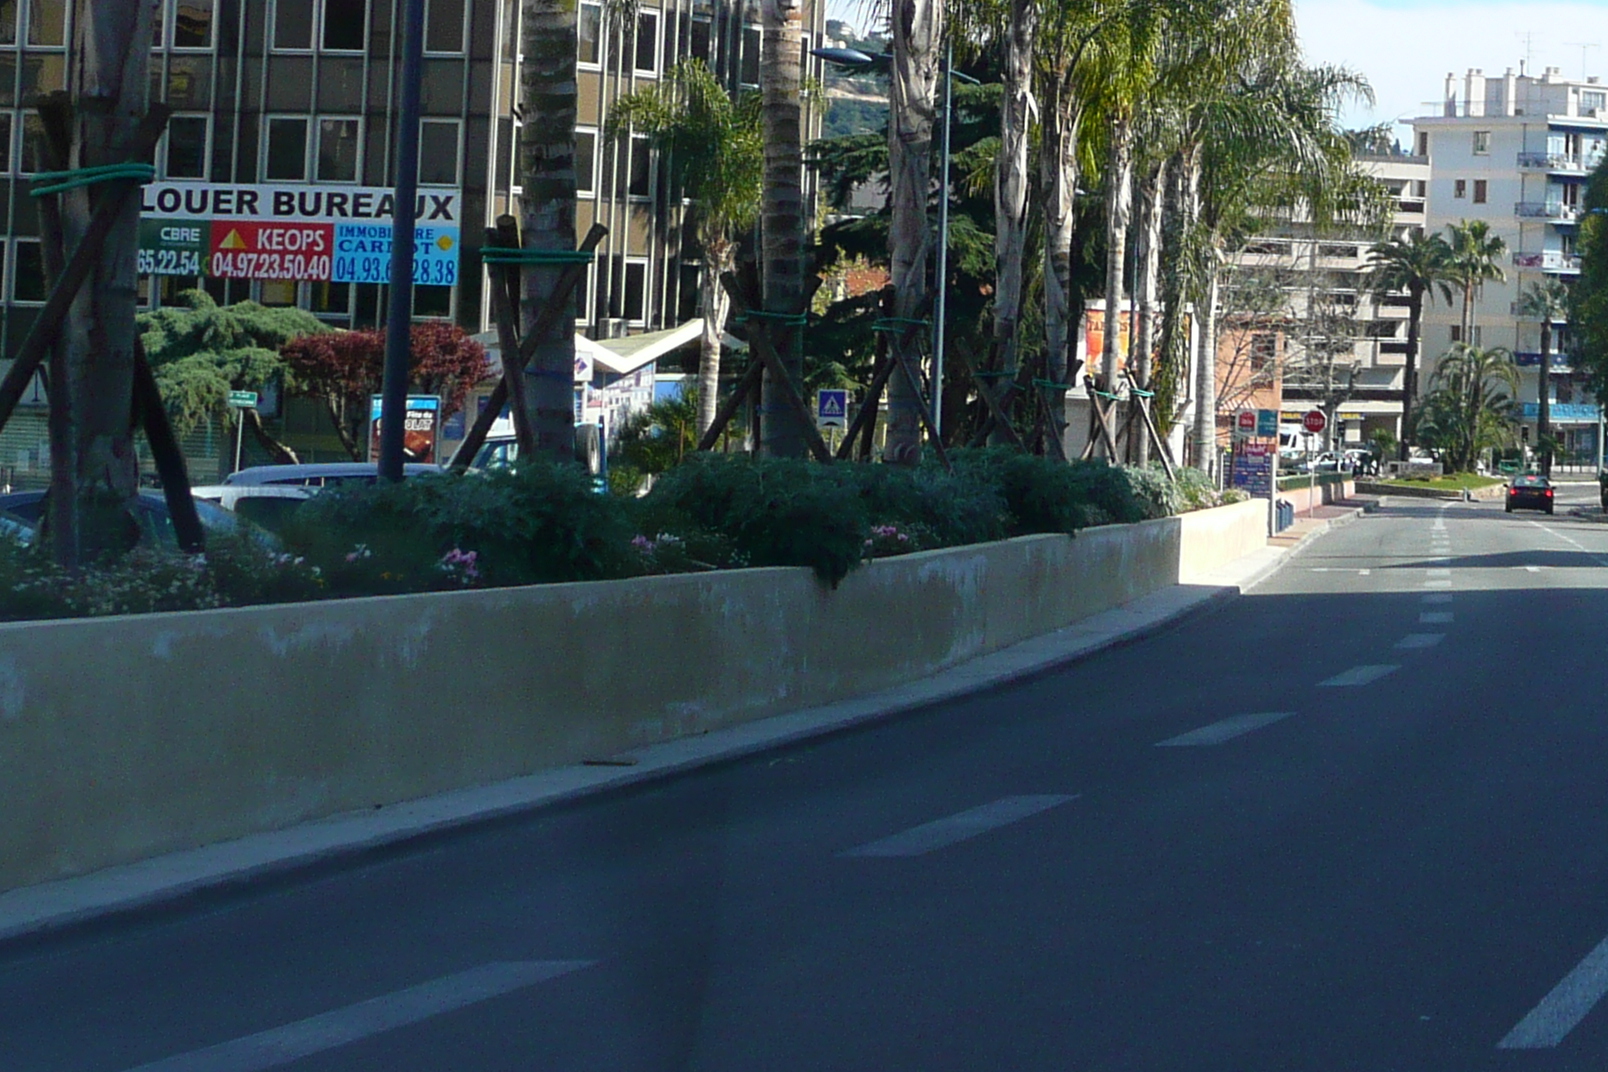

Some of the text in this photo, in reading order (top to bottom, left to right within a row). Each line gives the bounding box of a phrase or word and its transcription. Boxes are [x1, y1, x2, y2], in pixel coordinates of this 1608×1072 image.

[140, 188, 259, 215] LOUER
[161, 227, 200, 241] CBRE
[258, 229, 325, 251] KEOPS
[339, 226, 434, 240] IMMOBIRE
[338, 239, 434, 255] CART
[213, 252, 330, 279] 04.97.23.50.40
[336, 256, 455, 283] 04.93.628.38
[1304, 416, 1325, 426] STOP
